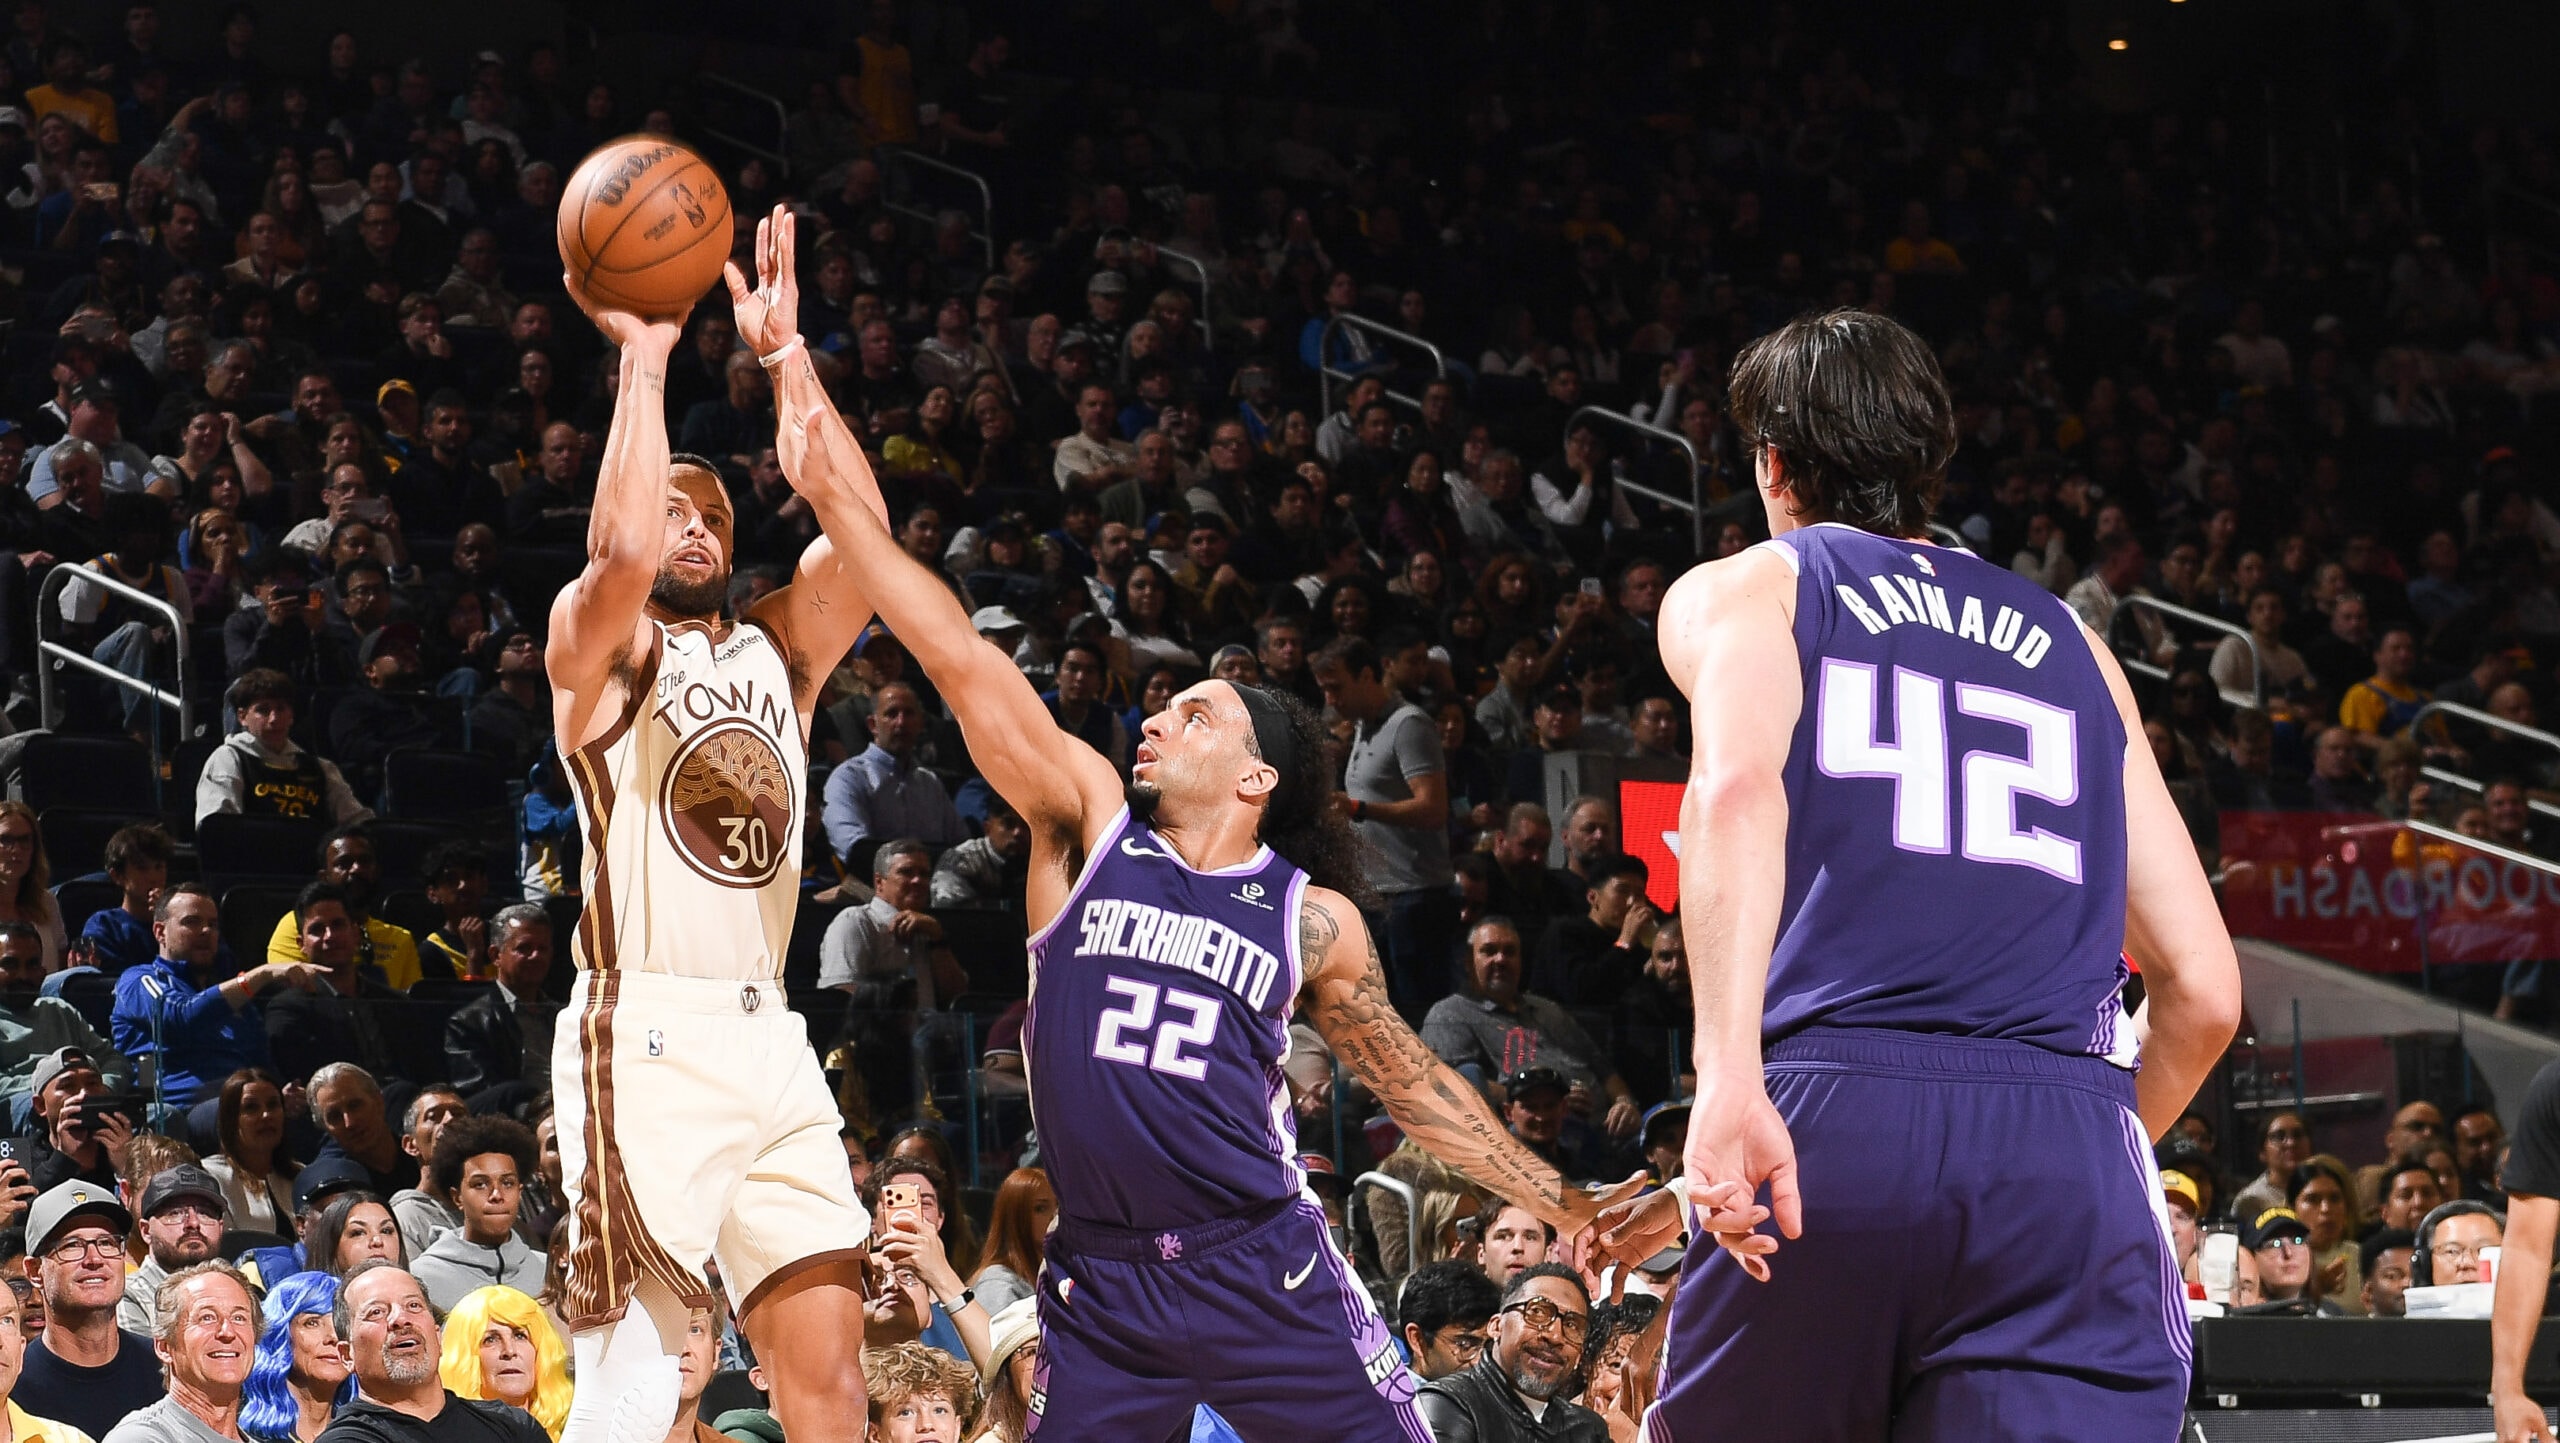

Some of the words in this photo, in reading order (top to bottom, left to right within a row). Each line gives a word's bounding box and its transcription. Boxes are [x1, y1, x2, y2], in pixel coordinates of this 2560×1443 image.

[1835, 573, 2052, 670] RAYNAUD
[657, 669, 687, 698] The
[652, 679, 786, 739] TOWN
[1816, 656, 2083, 885] 42
[718, 817, 769, 870] 30
[1074, 898, 1280, 1013] SACRAMENTO
[1092, 973, 1224, 1083] 22
[1369, 1021, 1382, 1032] It
[1372, 1031, 1393, 1052] gets
[1340, 1038, 1362, 1060] gets
[1356, 1057, 1383, 1084] better
[1360, 1036, 1386, 1067] before
[1380, 1065, 1393, 1075] it
[1471, 1122, 1492, 1139] God
